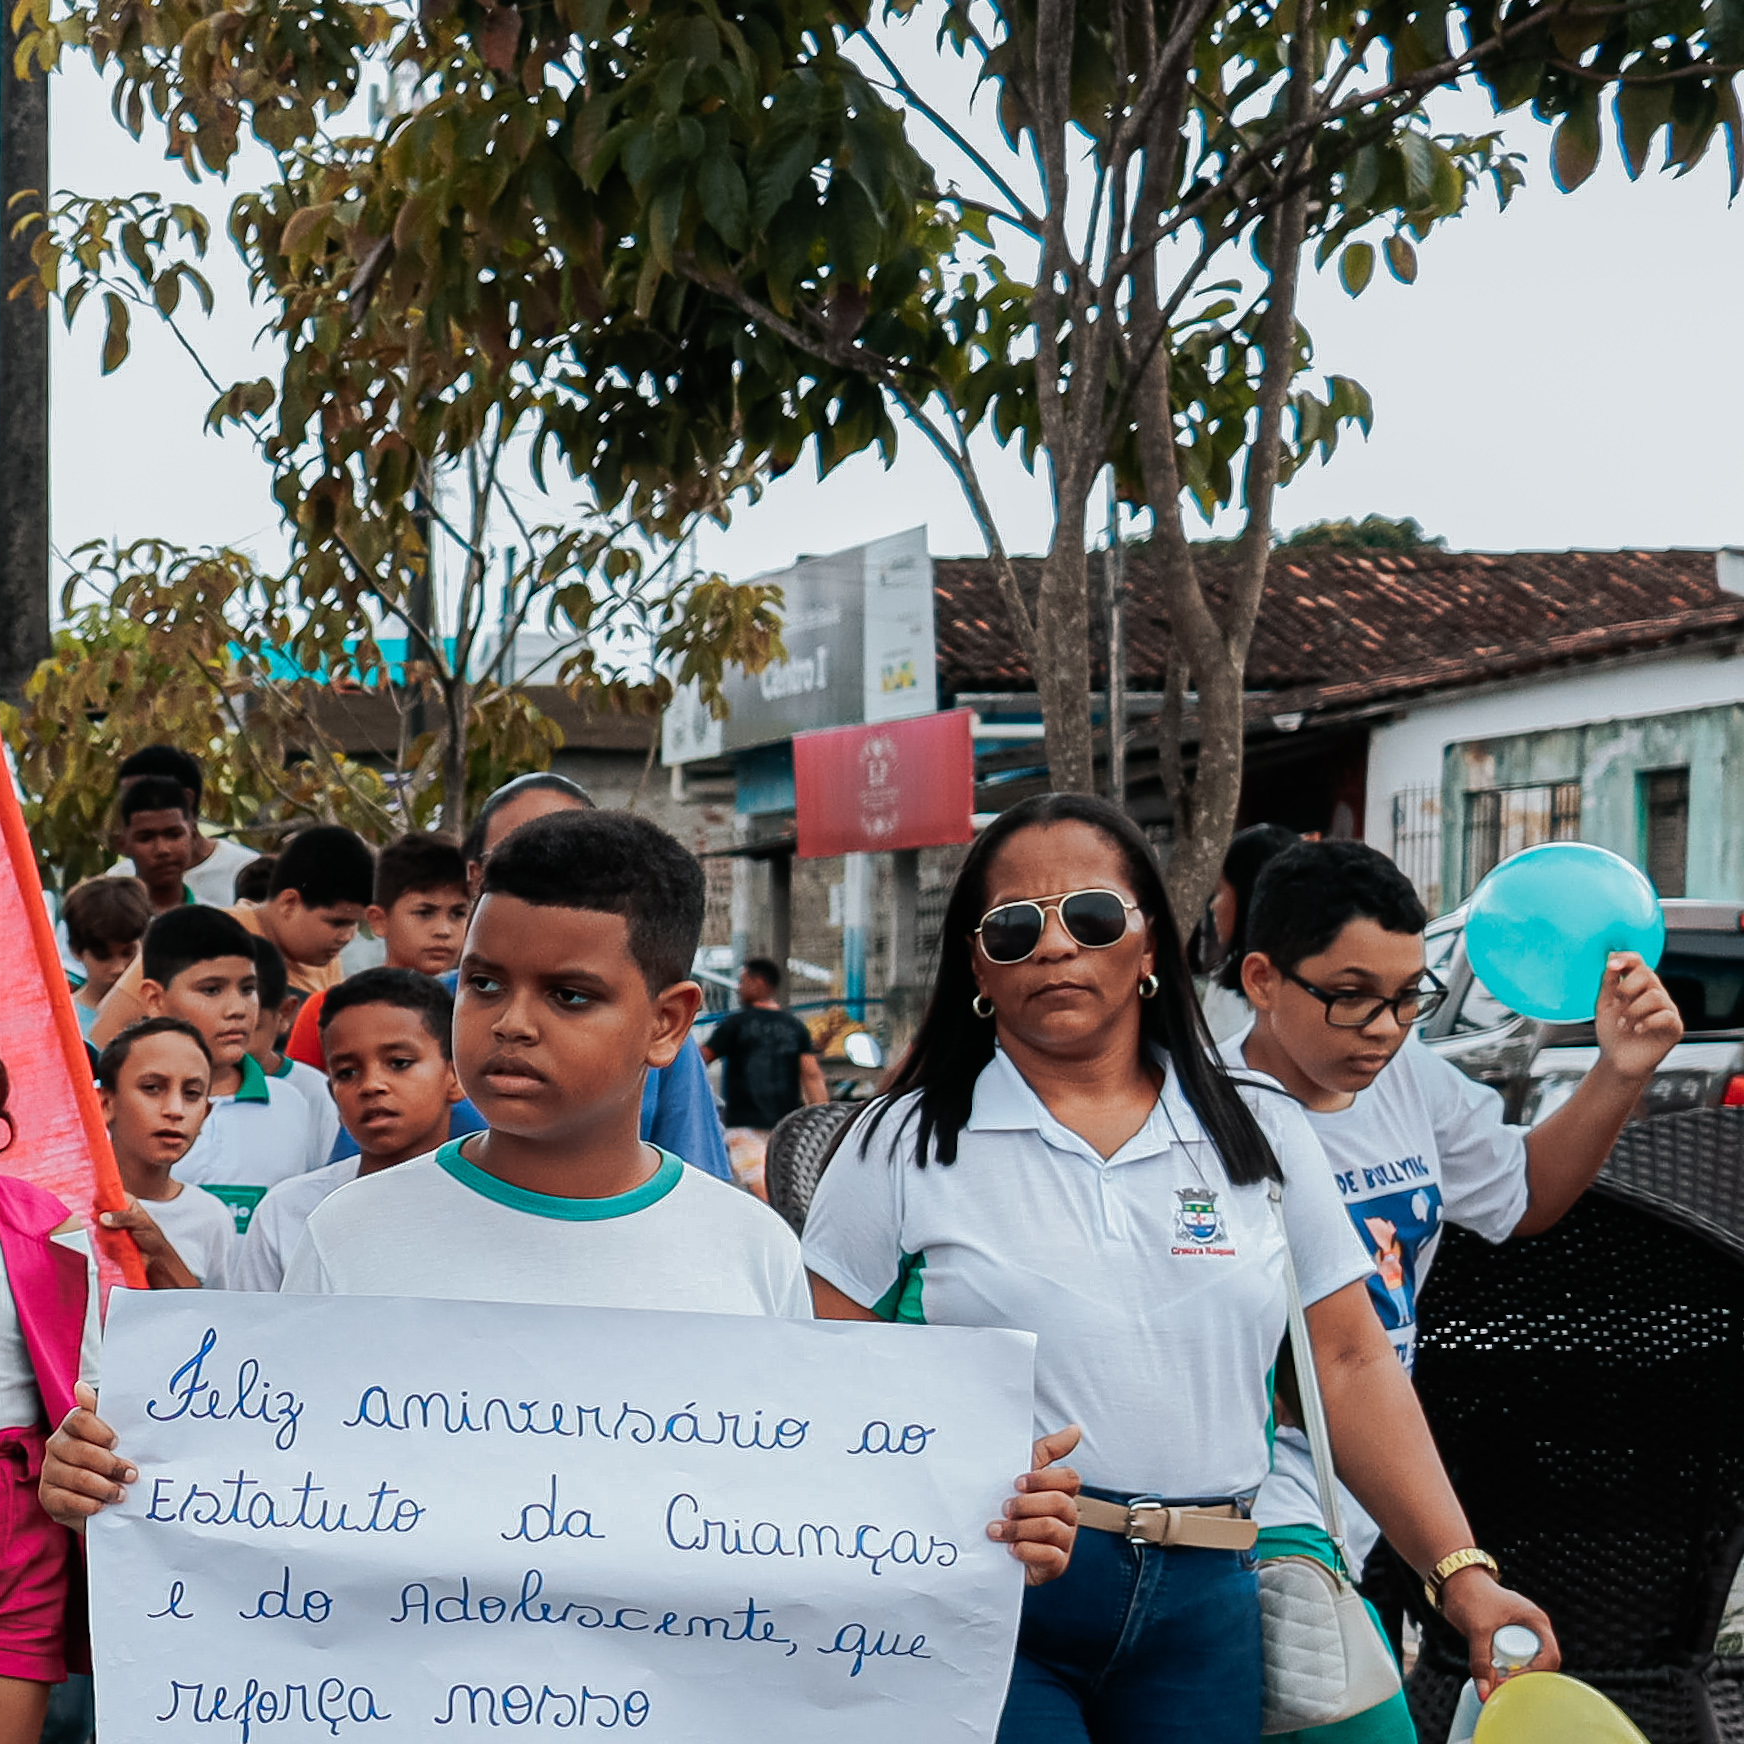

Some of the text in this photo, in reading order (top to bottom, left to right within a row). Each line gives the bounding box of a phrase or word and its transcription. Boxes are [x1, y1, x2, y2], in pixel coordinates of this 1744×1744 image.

[145, 1326, 937, 1455] Feliz aniversário ao
[145, 1469, 960, 1575] Estatuto da Crianças
[146, 1566, 934, 1678] e do Adolescente, que
[433, 1683, 652, 1729] nosso
